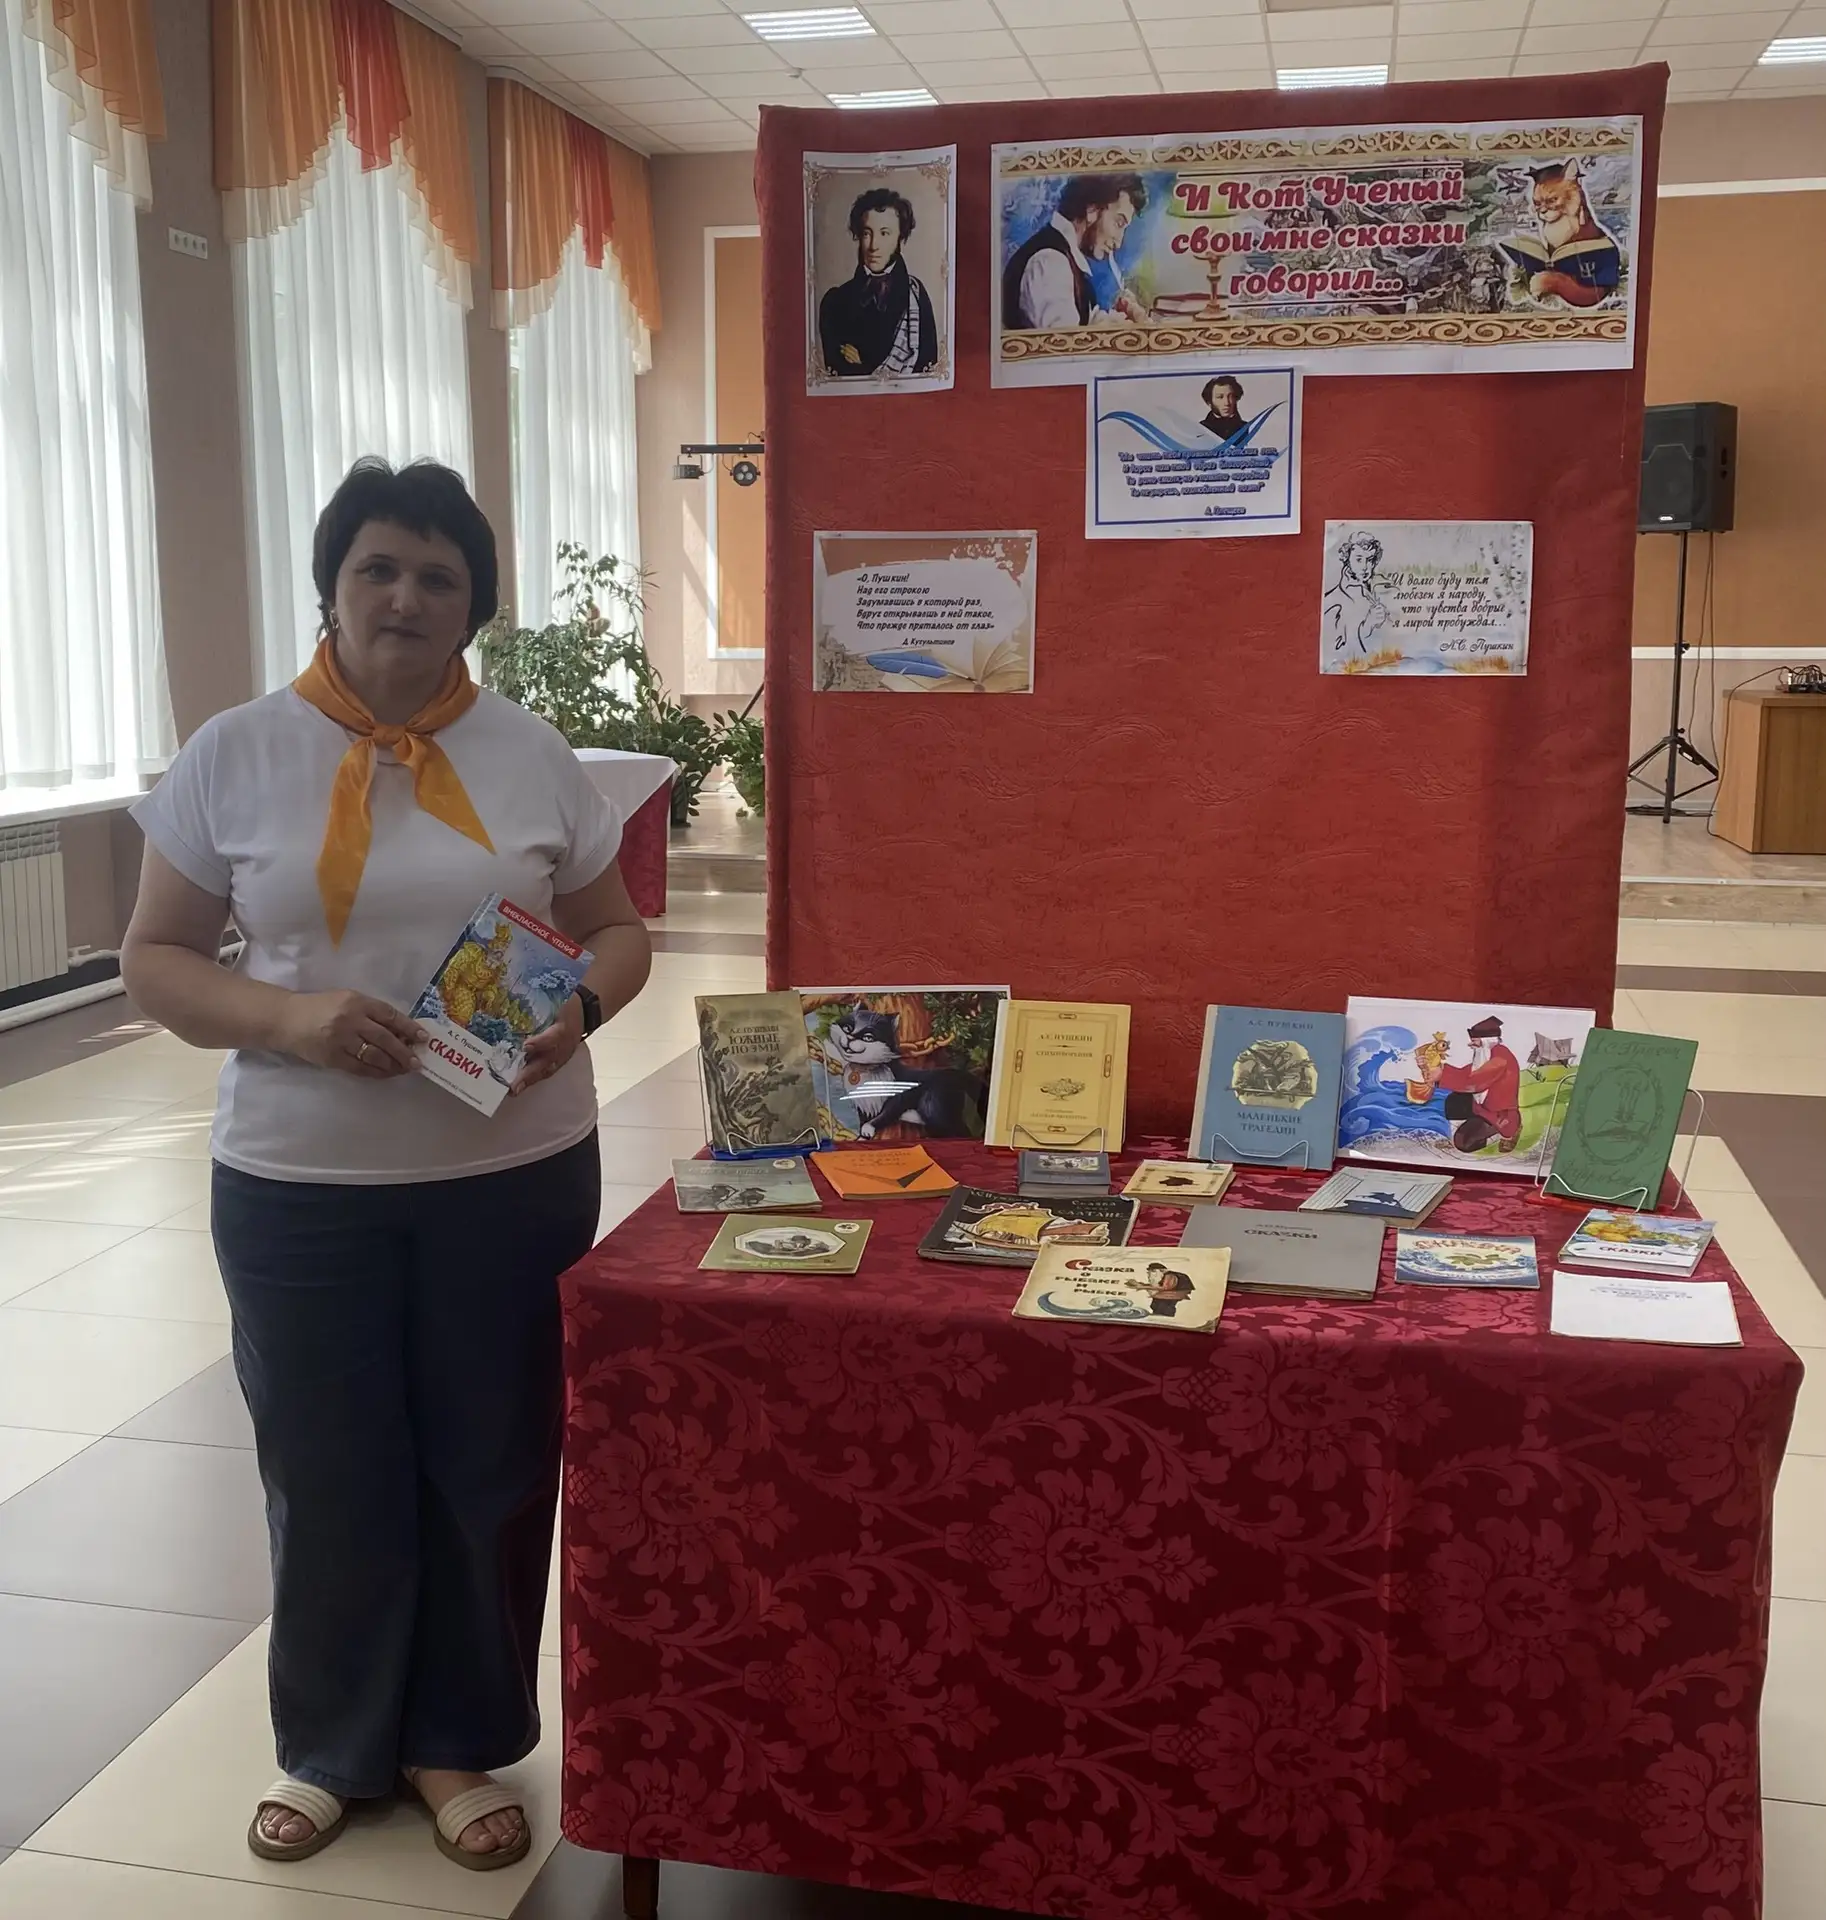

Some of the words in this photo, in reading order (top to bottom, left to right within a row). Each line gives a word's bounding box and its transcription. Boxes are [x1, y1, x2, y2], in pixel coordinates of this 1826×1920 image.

[1176, 182, 1211, 212] И
[1218, 179, 1305, 212] Кот
[1313, 170, 1462, 207] Ученый
[1171, 226, 1252, 254] свои
[1260, 228, 1331, 251] мне
[1338, 224, 1465, 248] сказки
[1231, 265, 1402, 299] говорил...
[872, 573, 910, 584] Пушкин!
[1407, 572, 1434, 586] долго
[1437, 572, 1462, 590] буду
[1465, 576, 1490, 586] тем
[856, 586, 873, 595] Над
[890, 587, 930, 596] строкою
[1393, 587, 1435, 601] любезен
[1437, 591, 1445, 600] я
[1448, 586, 1486, 604] народу,
[856, 599, 915, 607] Задумавшись
[923, 597, 963, 608] который
[964, 599, 982, 608] раз,
[856, 609, 882, 620] Вдруг
[883, 611, 938, 620] открываешь
[947, 609, 962, 618] ней
[964, 611, 994, 619] такое,
[1401, 605, 1422, 614] что
[1426, 600, 1468, 620] чувства
[1471, 600, 1505, 617] добрые
[857, 621, 875, 630] Что
[876, 622, 908, 631] прежде
[909, 622, 954, 631] пряталось
[1392, 620, 1400, 628] я
[1403, 617, 1434, 632] лирой
[1470, 638, 1514, 655] Пушкин
[502, 905, 551, 939] ВНЕКЛАССНОЕ
[551, 935, 577, 956] ЧТЕНИЕ
[729, 1033, 780, 1045] ЮЖНЫЕ
[461, 1038, 484, 1056] Пушкин
[731, 1043, 780, 1055] ПОЭМЫ
[428, 1038, 484, 1080] СКАЗКИ
[1237, 1111, 1302, 1124] МАЛЕНЬКИЕ
[1240, 1122, 1296, 1135] ТРАГЕДИИ
[1244, 1229, 1318, 1239] СКАЗКИ
[1599, 1246, 1664, 1256] СКАЗКИ
